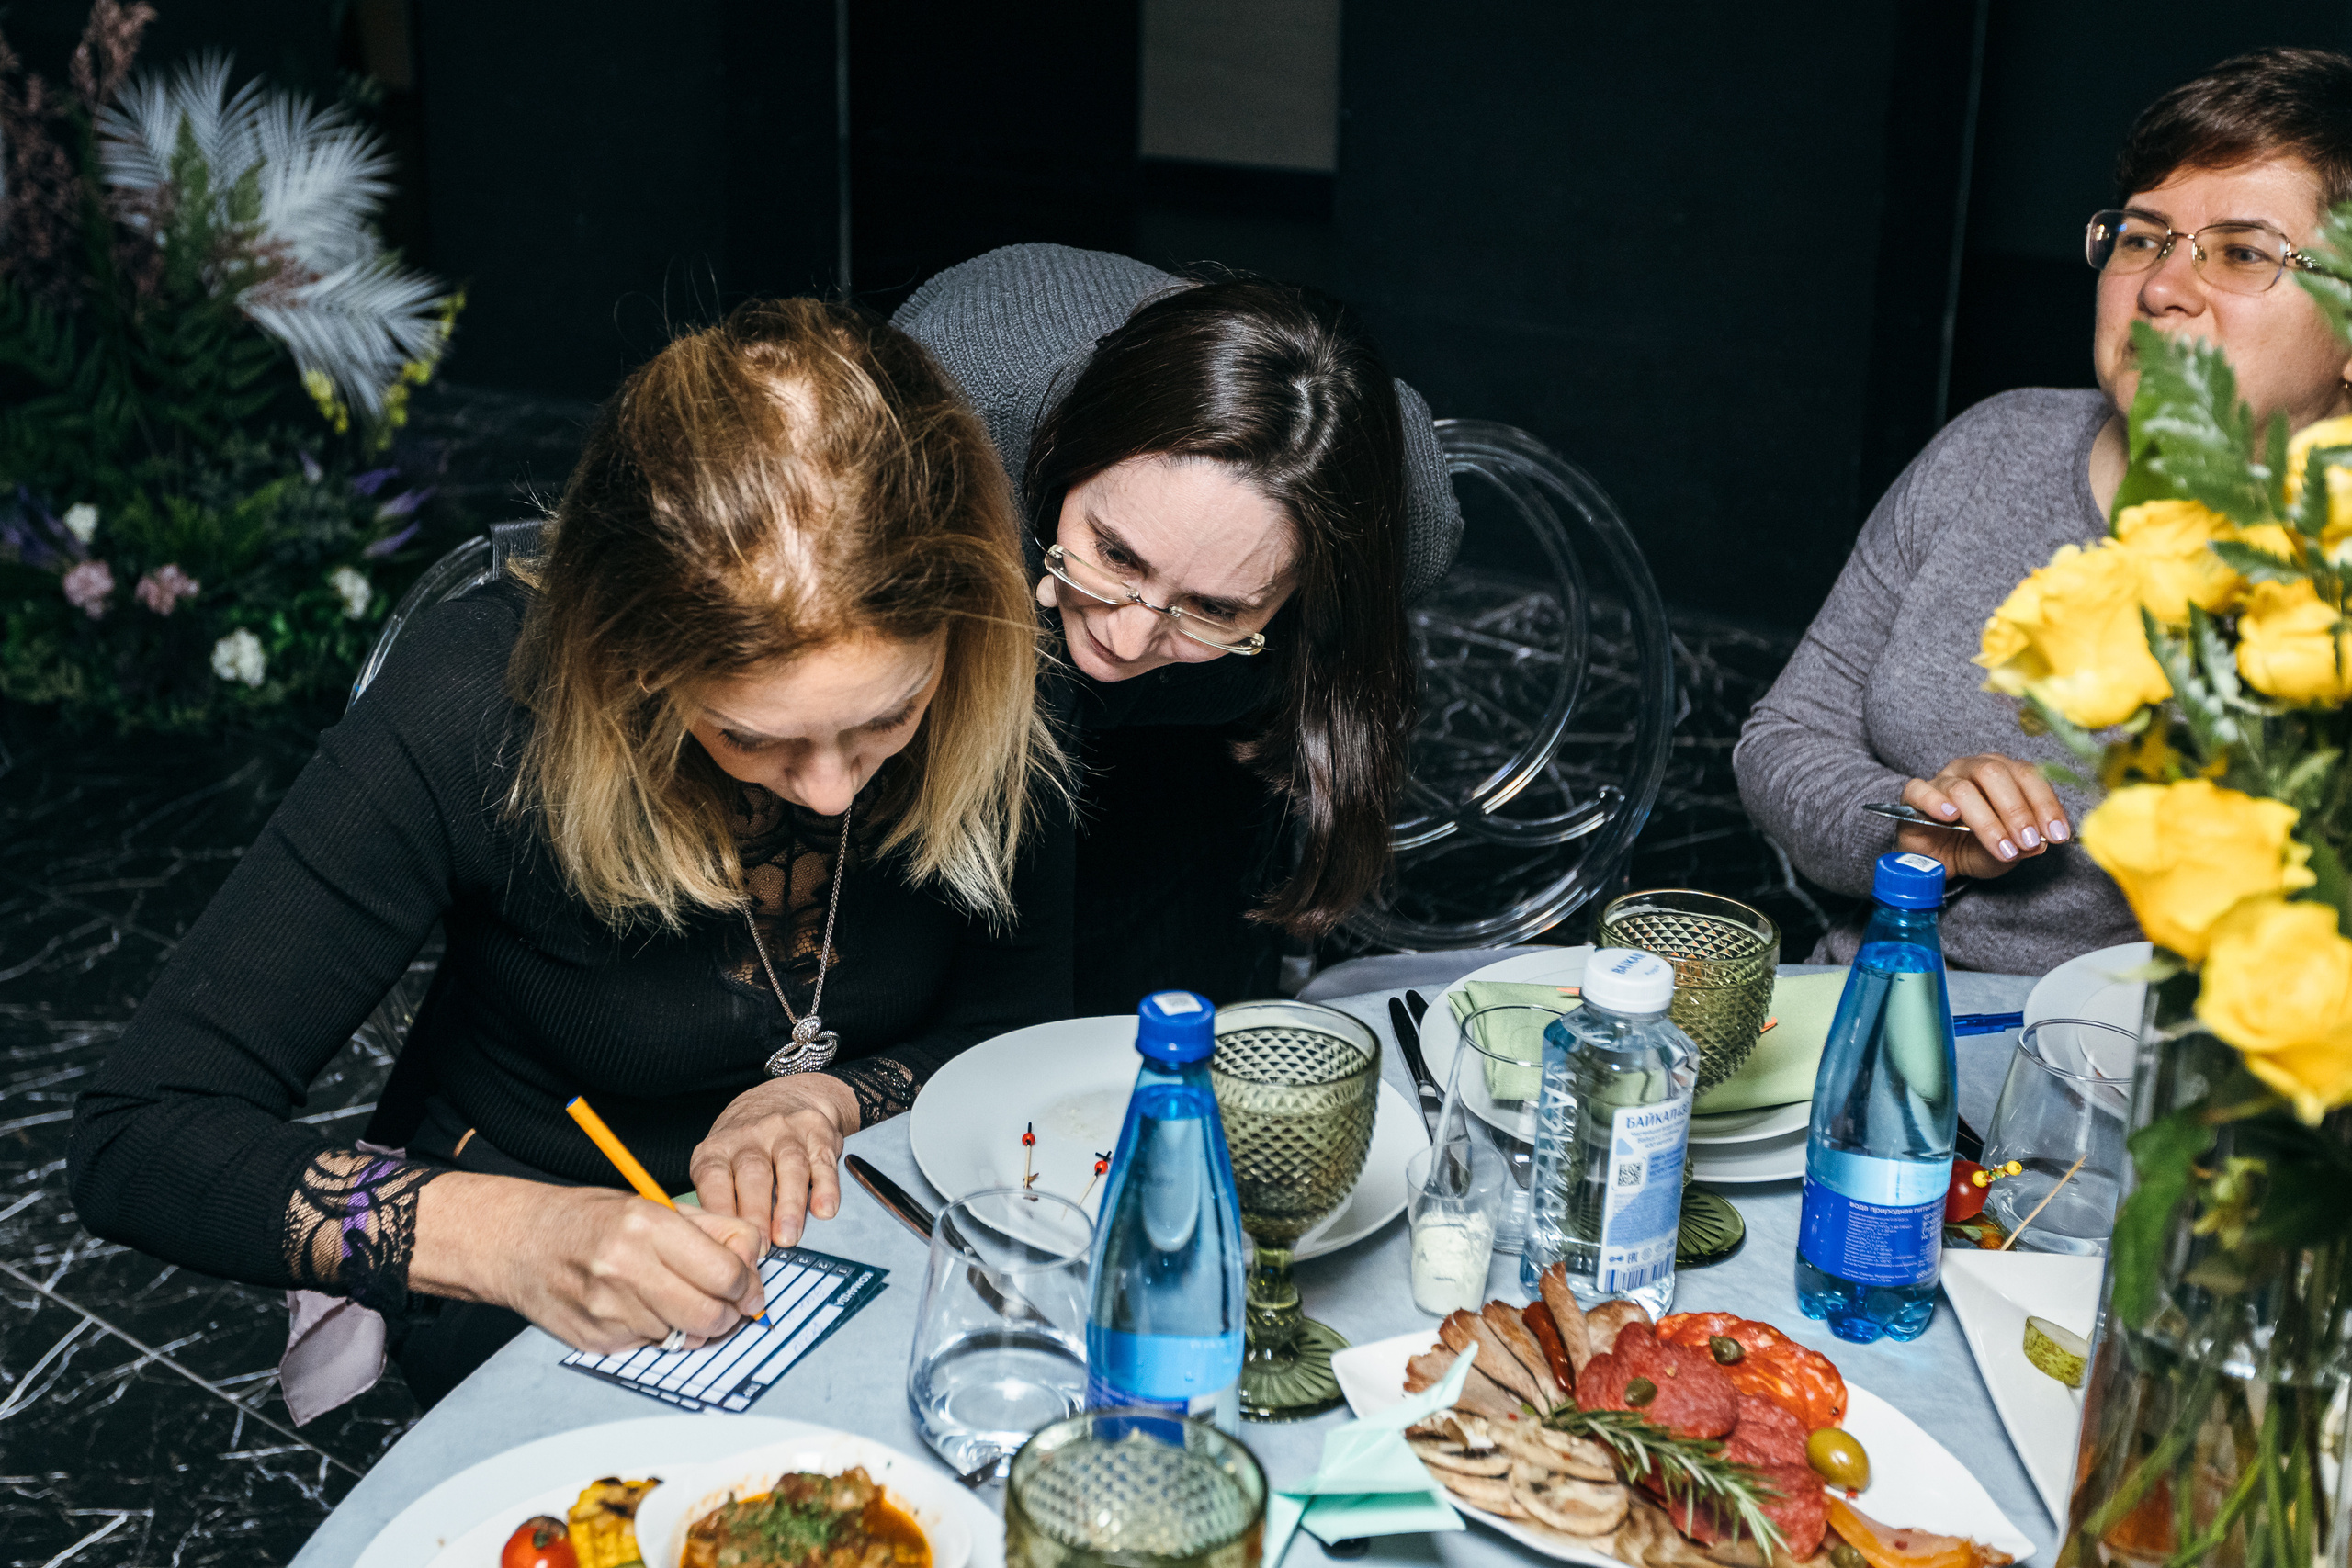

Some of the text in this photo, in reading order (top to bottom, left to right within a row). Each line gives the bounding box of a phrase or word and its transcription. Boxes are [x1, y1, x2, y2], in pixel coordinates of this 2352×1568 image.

[1849, 1201, 1869, 1212] вода
[1870, 1206, 1913, 1215] природная
[834, 1269, 875, 1306] КОМАНДА
